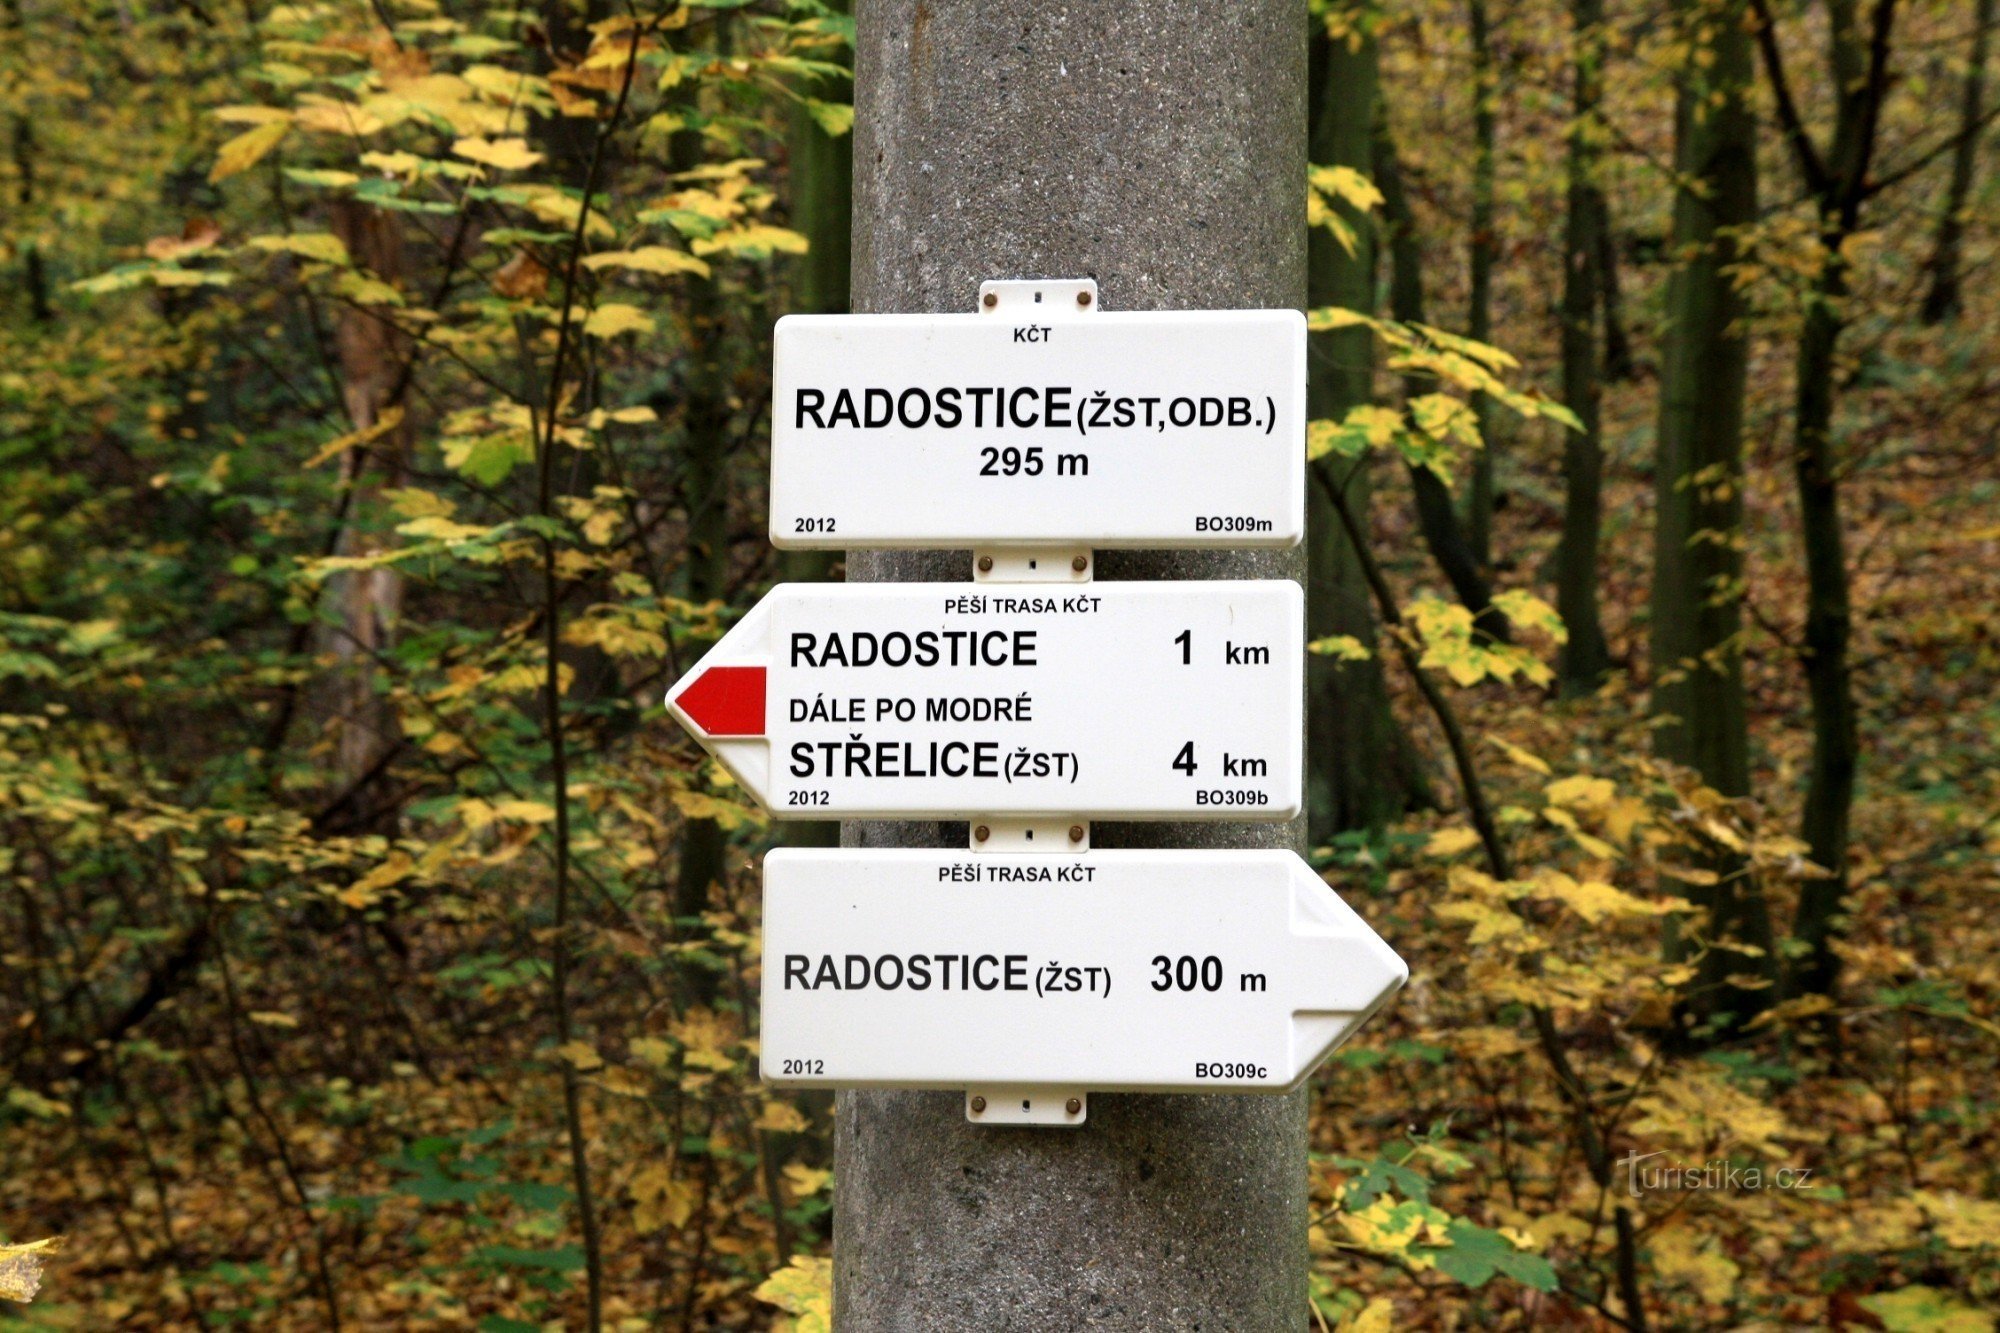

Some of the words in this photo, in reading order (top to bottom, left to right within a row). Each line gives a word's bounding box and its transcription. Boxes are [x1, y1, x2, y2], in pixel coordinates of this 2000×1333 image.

[1013, 324, 1052, 343] KČT
[979, 446, 1044, 477] 295
[1057, 453, 1089, 476] m
[795, 517, 836, 533] 2012
[1195, 516, 1273, 532] BO309m
[944, 595, 987, 614] PĚŠÍ
[992, 598, 1058, 614] TRASA
[1063, 594, 1102, 613] KČT
[790, 630, 1037, 668] RADOSTICE
[1174, 629, 1191, 665] 1
[1225, 640, 1270, 665] km
[789, 692, 866, 723] DÁLE
[876, 697, 916, 723] PO
[925, 691, 1032, 722] MODRÉ
[1172, 740, 1198, 777] 4
[1223, 752, 1267, 777] km
[788, 790, 830, 806] 2012
[1196, 789, 1269, 806] BO309b
[938, 863, 981, 882] PĚŠÍ
[986, 866, 1052, 882] TRASA
[1057, 863, 1096, 882] KČT
[1150, 955, 1223, 992] 300
[1240, 973, 1267, 992] m
[782, 1059, 824, 1075] 2012
[1195, 1062, 1267, 1079] BO309c
